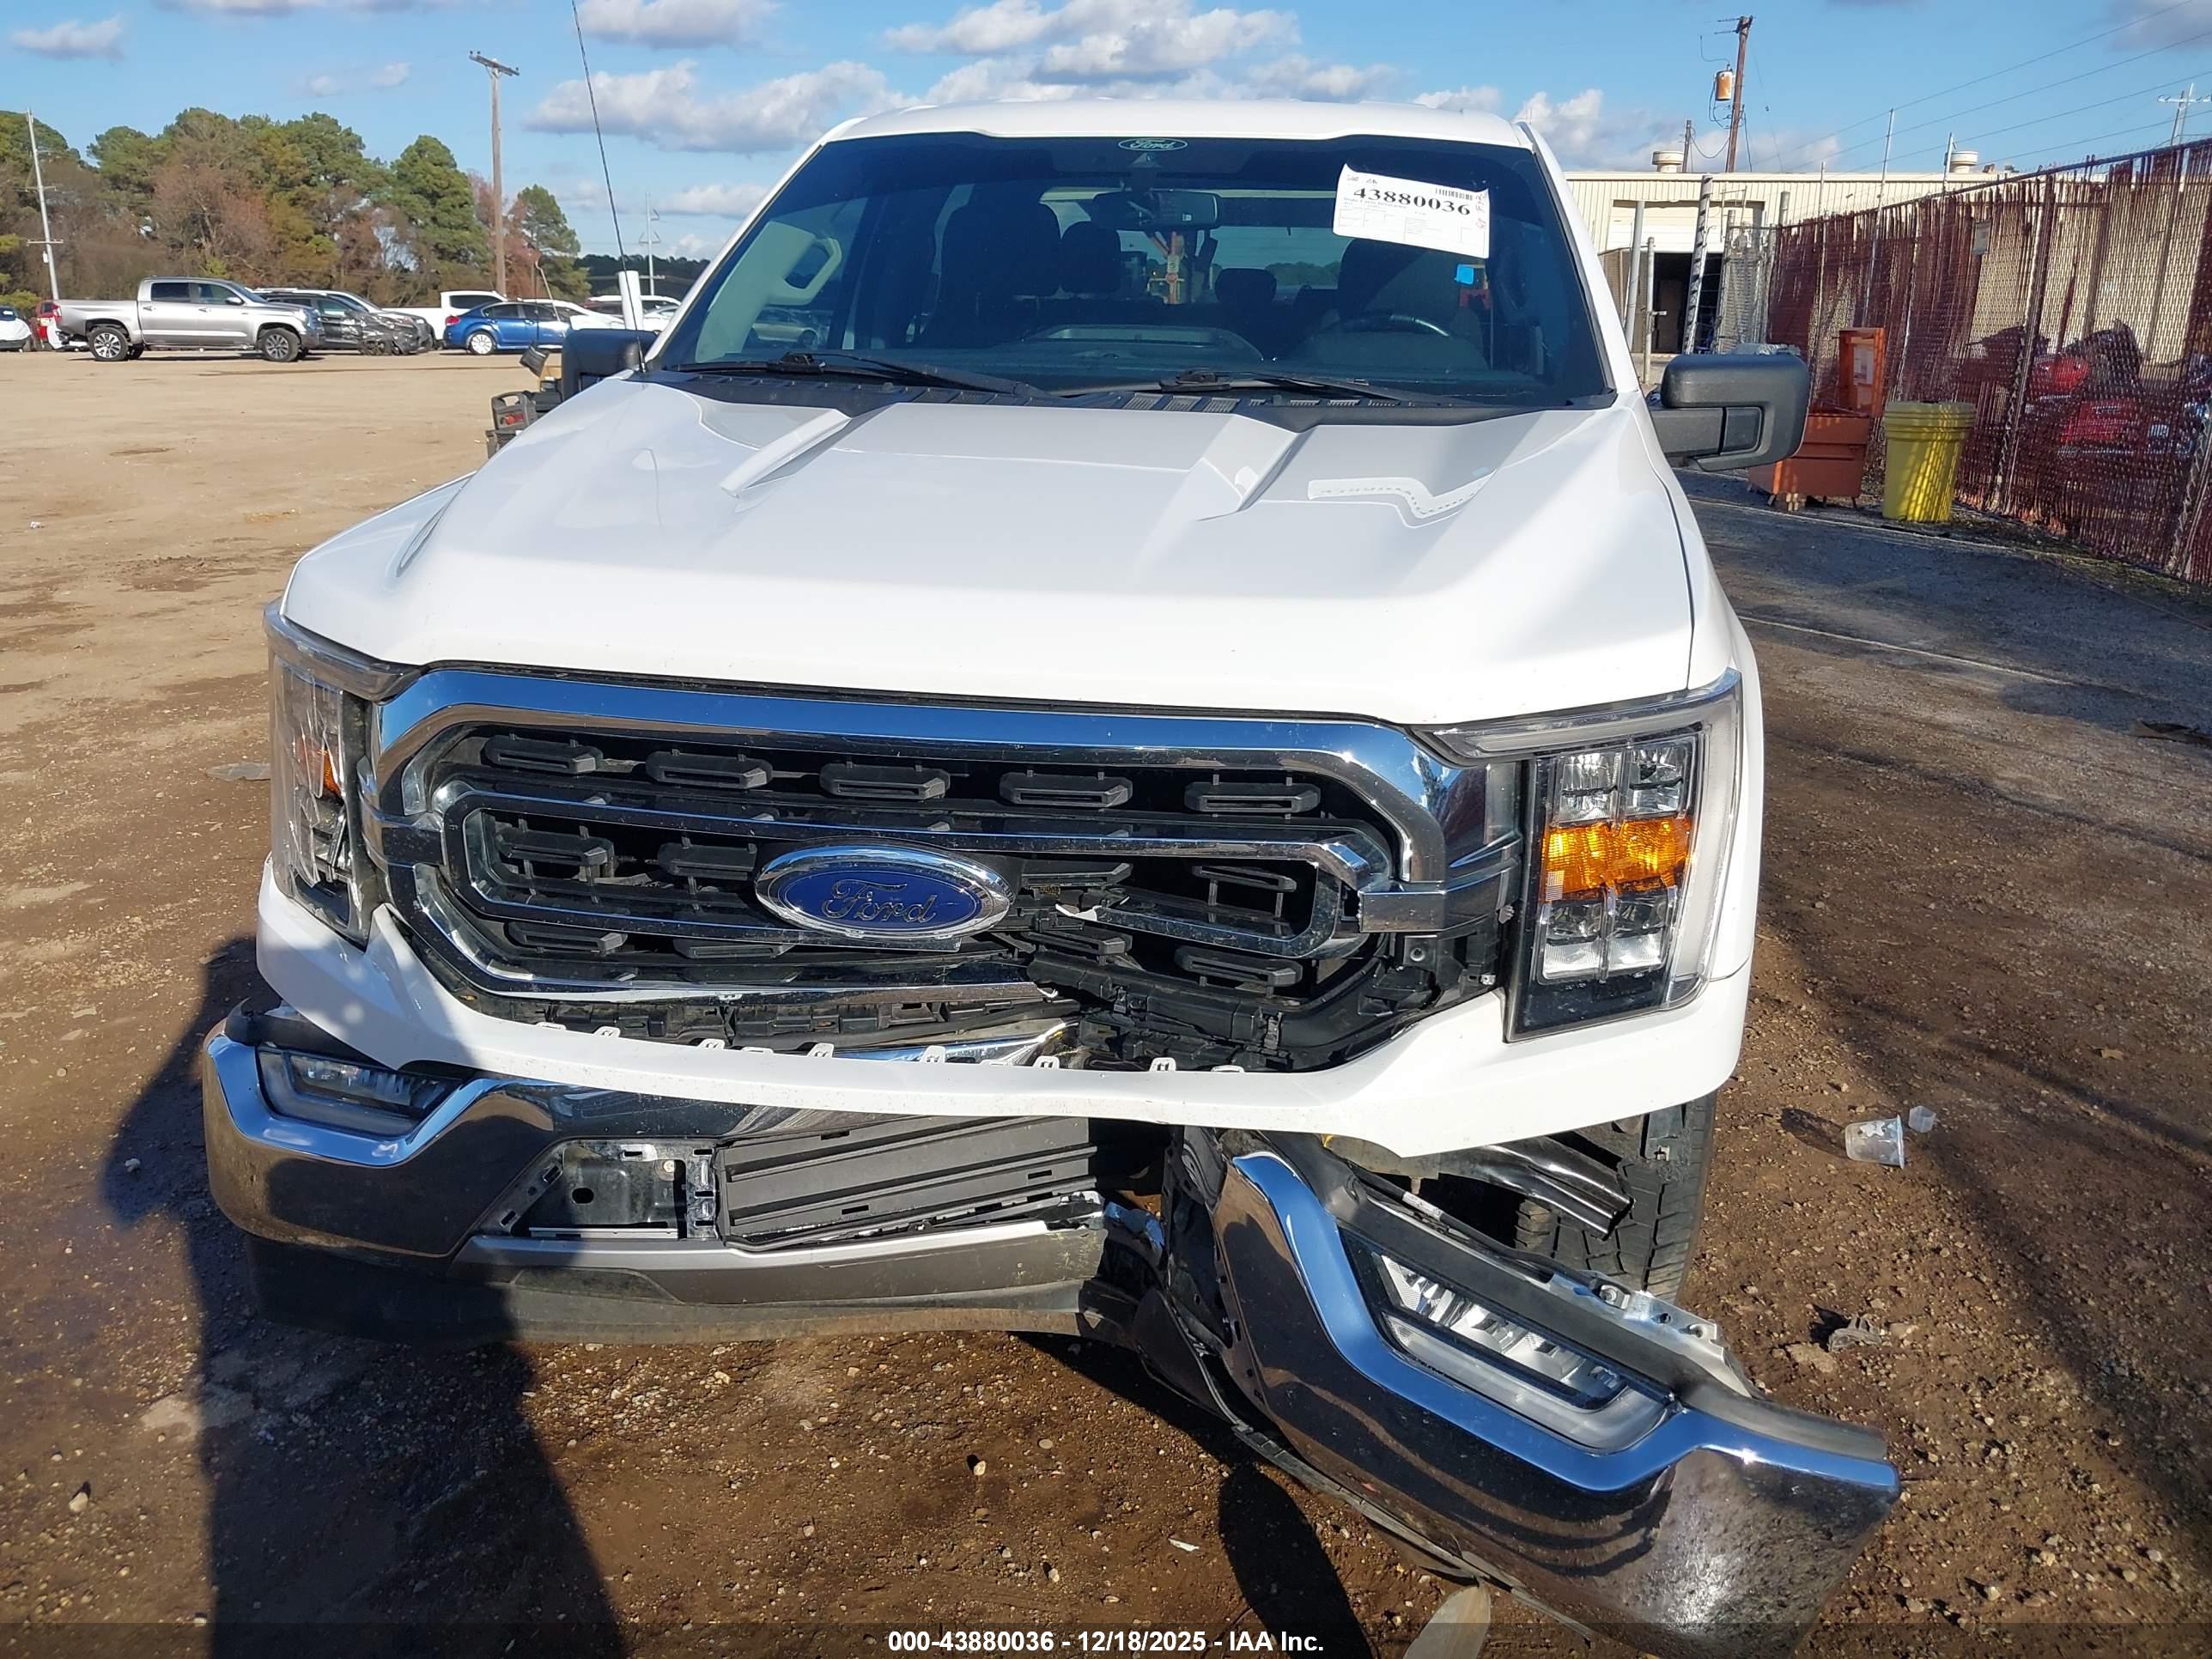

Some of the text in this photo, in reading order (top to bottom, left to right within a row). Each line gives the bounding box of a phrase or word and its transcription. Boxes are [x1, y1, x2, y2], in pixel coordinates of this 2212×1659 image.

[1130, 139, 1176, 149] Ford
[1352, 186, 1471, 216] 43880036
[821, 878, 937, 922] Ford
